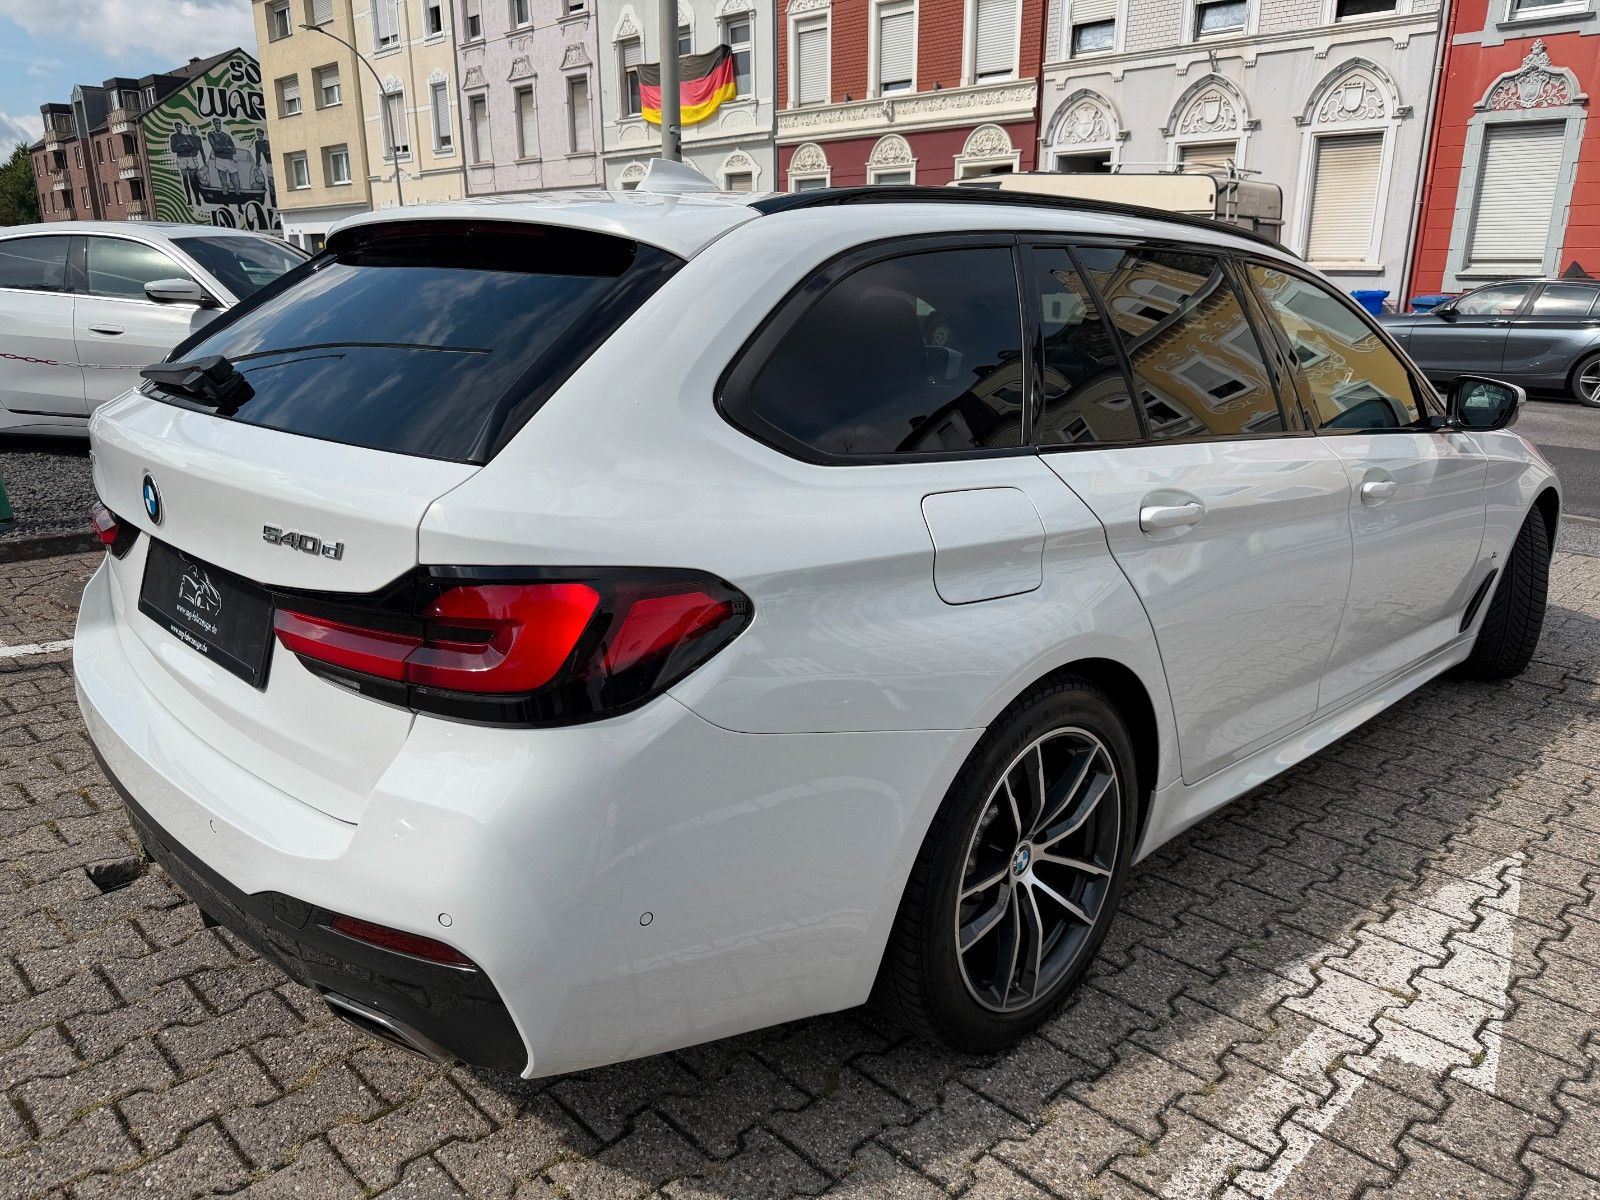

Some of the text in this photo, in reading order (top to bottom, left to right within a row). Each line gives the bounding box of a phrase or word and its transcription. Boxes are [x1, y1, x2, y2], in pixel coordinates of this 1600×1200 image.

[229, 60, 262, 85] SO
[196, 86, 267, 121] WAR
[262, 525, 345, 562] 540d
